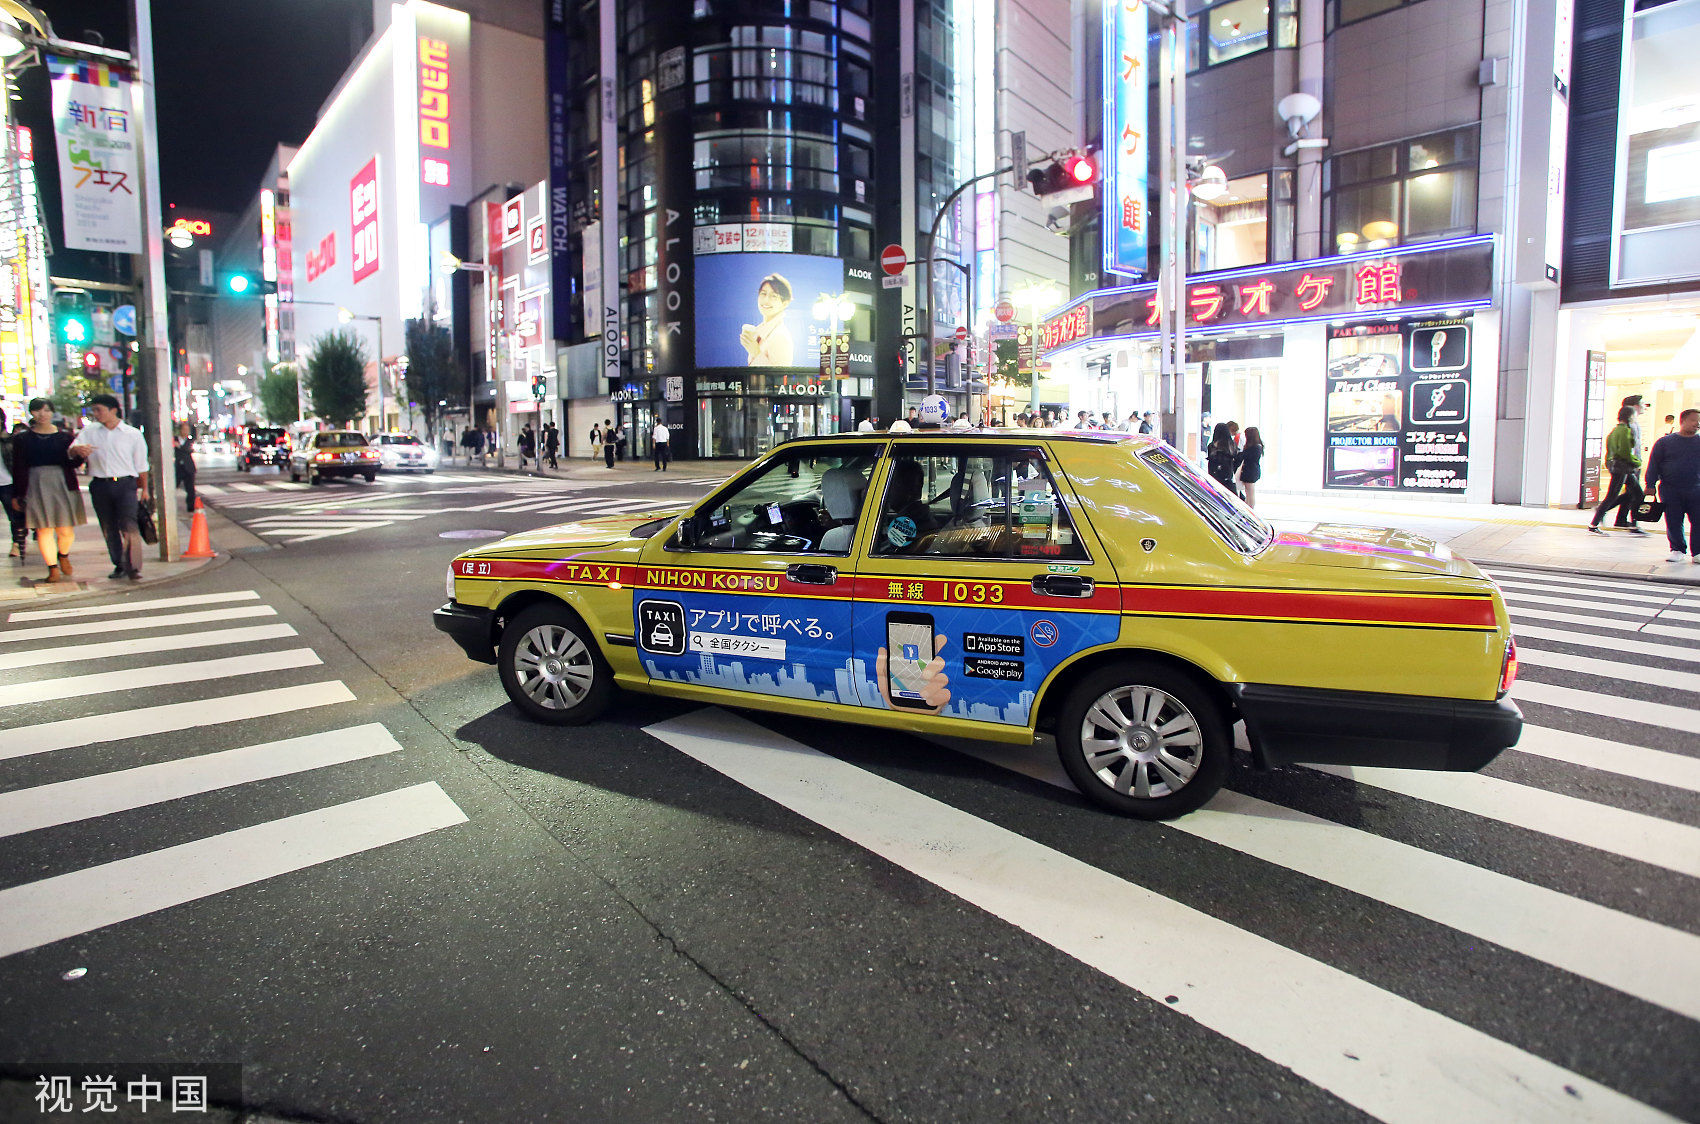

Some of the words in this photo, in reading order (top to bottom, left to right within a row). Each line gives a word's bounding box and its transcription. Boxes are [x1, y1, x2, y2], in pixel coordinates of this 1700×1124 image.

[68, 101, 128, 133] 新宿
[73, 166, 132, 194] フェス
[665, 208, 681, 336] ALOOK
[848, 267, 872, 280] ALOOK
[1366, 323, 1399, 335] ROOM
[606, 306, 619, 368] ALOOK
[849, 353, 873, 363] ALOOK
[778, 384, 826, 396] ALOOK
[1330, 437, 1373, 446] PROJECTOR
[1374, 437, 1397, 446] ROOM
[462, 562, 491, 575] (足立)
[567, 565, 621, 581] TAXI
[647, 570, 706, 587] NIHON
[712, 573, 779, 591] KOTSU
[887, 581, 924, 600] 無線
[943, 582, 1004, 603] 1033
[646, 610, 676, 622] TAXI
[689, 608, 834, 640] アプリで呼べる。
[709, 637, 770, 652] 全国タクシー
[977, 642, 996, 652] App
[998, 643, 1020, 653] Store
[976, 665, 1005, 678] Google
[1006, 668, 1023, 680] play
